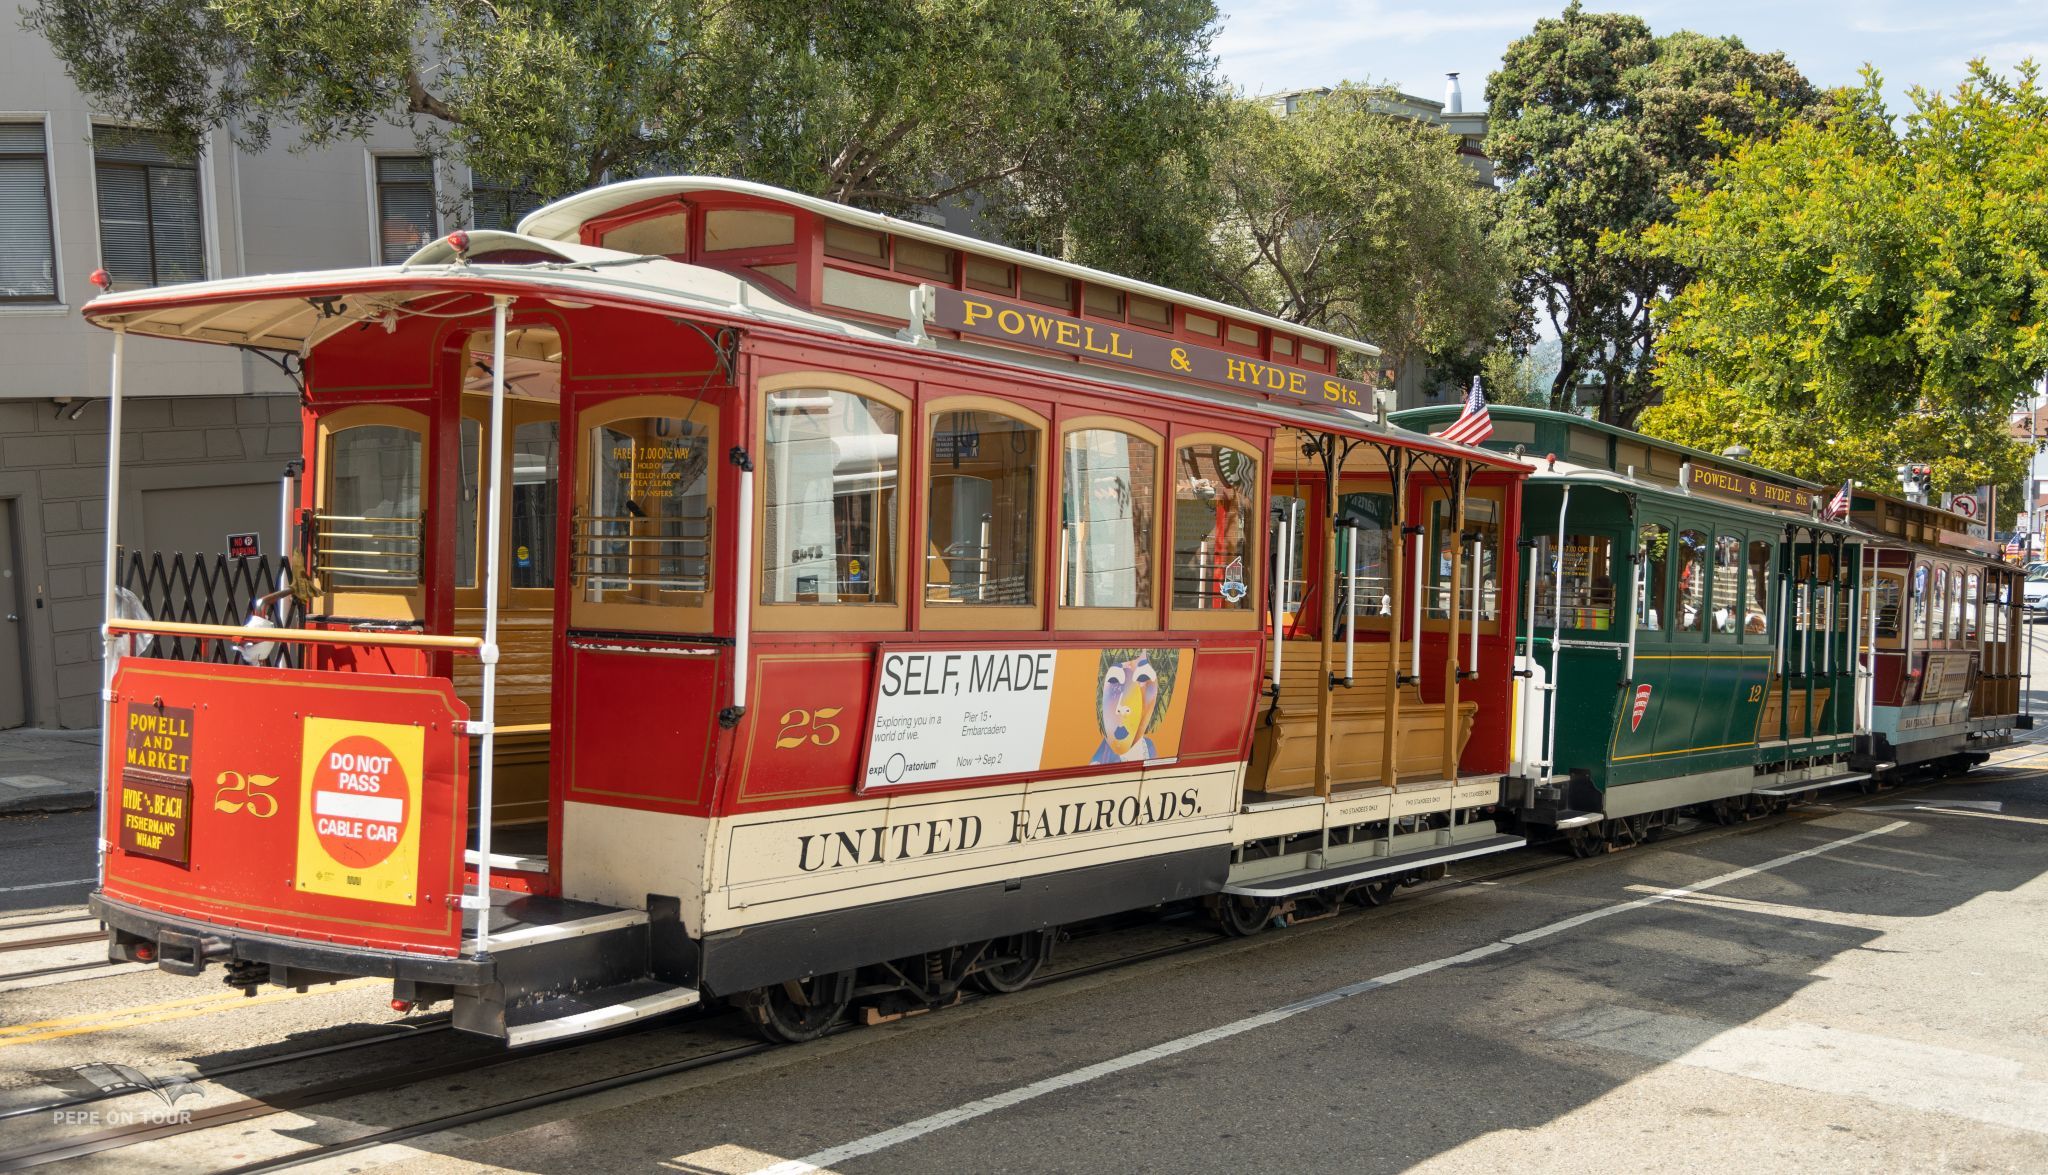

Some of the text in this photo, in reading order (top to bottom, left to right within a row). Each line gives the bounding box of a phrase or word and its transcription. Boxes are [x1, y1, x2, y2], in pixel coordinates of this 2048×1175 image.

[962, 300, 1361, 406] POWELL & HYDE Sts.
[658, 447, 673, 460] ONE
[674, 447, 690, 460] WAY
[637, 462, 653, 470] HOLD
[1694, 469, 1742, 493] POWELL
[1749, 481, 1757, 496] &
[1764, 485, 1791, 503] HYDE
[234, 537, 243, 546] NO
[881, 653, 1052, 697] SELF, MADE
[1748, 684, 1762, 703] 12
[130, 713, 189, 738] POWELL
[876, 715, 942, 730] Exploring you in a
[964, 710, 988, 722] Pier 15
[775, 706, 844, 749] 25
[874, 729, 919, 743] world of we.
[961, 723, 1007, 737] Embarcadero
[143, 735, 173, 752] AND
[127, 753, 189, 773] MARKET
[331, 752, 392, 775] DO NOT
[956, 753, 1003, 768] Now Sep 2
[339, 772, 380, 793] PASS
[123, 788, 143, 811] HYDE
[154, 794, 182, 819] BEACH
[213, 771, 279, 818] 25
[1413, 797, 1432, 806] STANDEES
[1349, 805, 1368, 815] STANDEES
[126, 814, 175, 837] FISHERMANS
[318, 817, 398, 843] CABLE CAR
[798, 788, 1203, 872] UNITED RAILROADS.
[136, 832, 162, 850] WHARF
